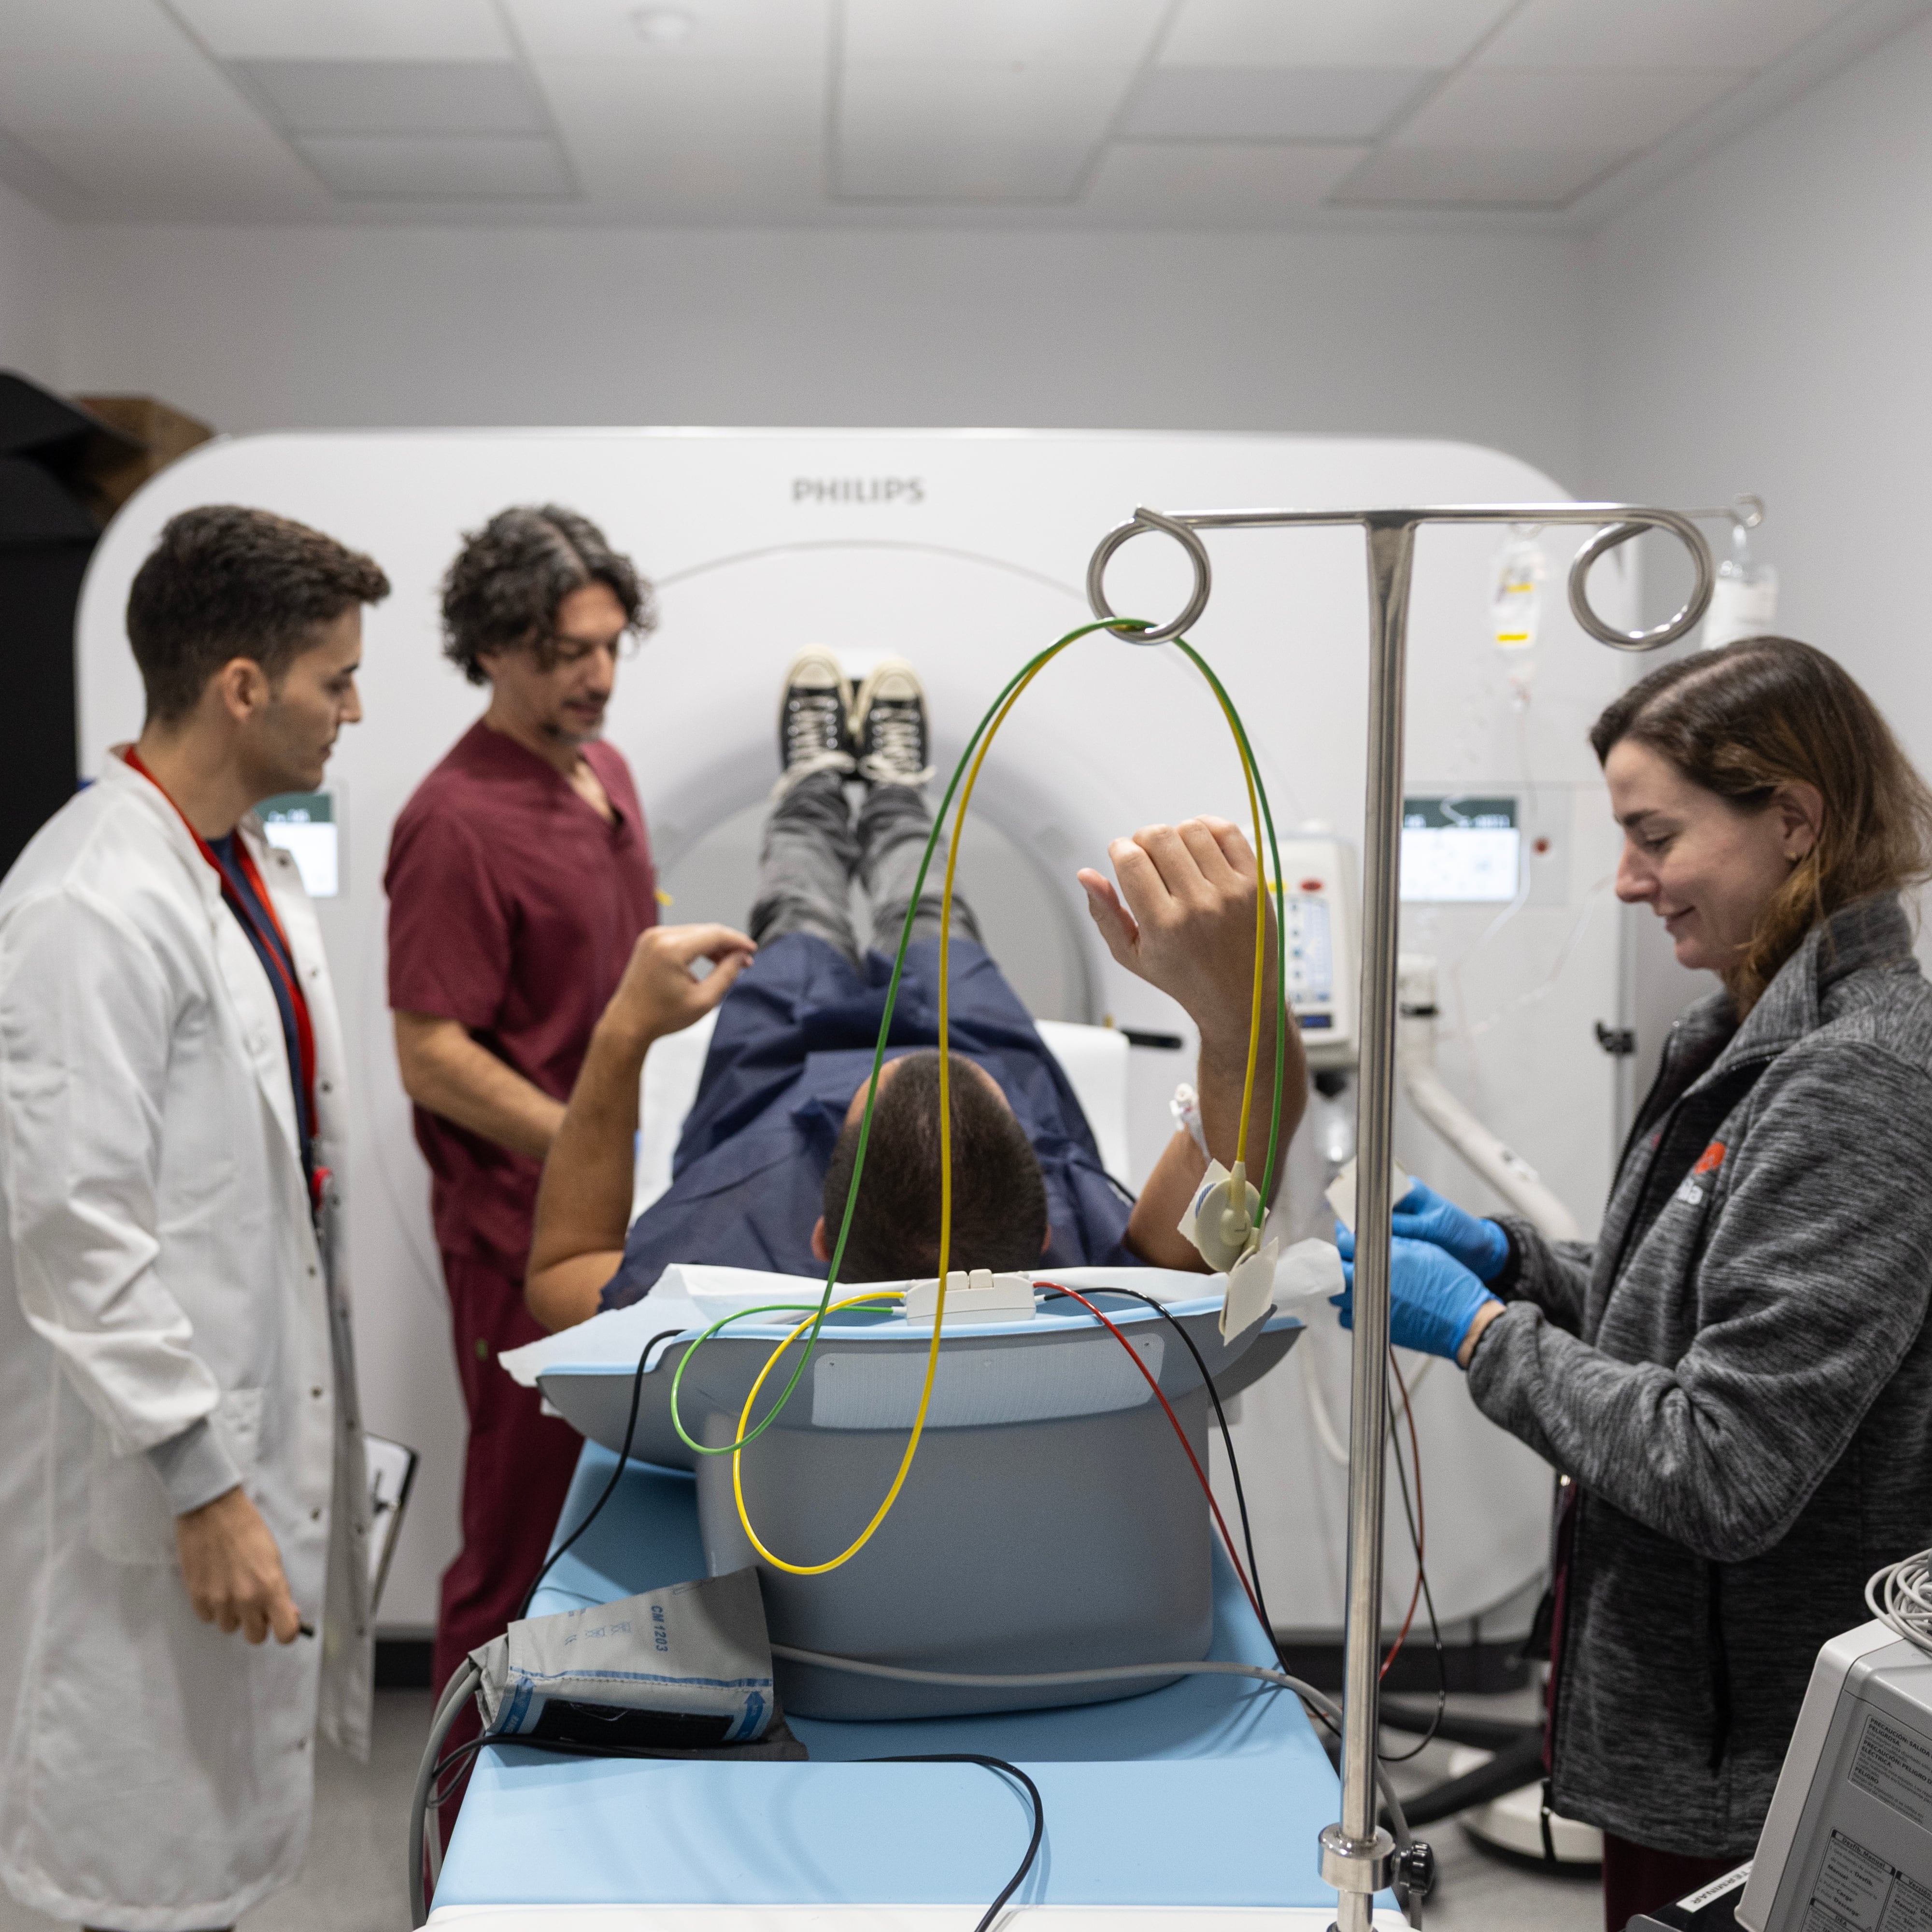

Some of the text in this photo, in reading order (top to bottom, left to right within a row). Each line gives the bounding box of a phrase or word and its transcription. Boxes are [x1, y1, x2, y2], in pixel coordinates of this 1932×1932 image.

[792, 477, 924, 504] PHILIPS
[651, 1605, 668, 1651] CM 1203
[1863, 1739, 1902, 1765] PRECAUCIÓN:
[1902, 1763, 1927, 1780] PELIGRO
[1909, 1741, 1930, 1756] SALIDA
[1855, 1767, 1879, 1783] PELIGRO
[1842, 1837, 1885, 1866] Desfib. Manual
[1693, 1871, 1749, 1904] TERMINAR
